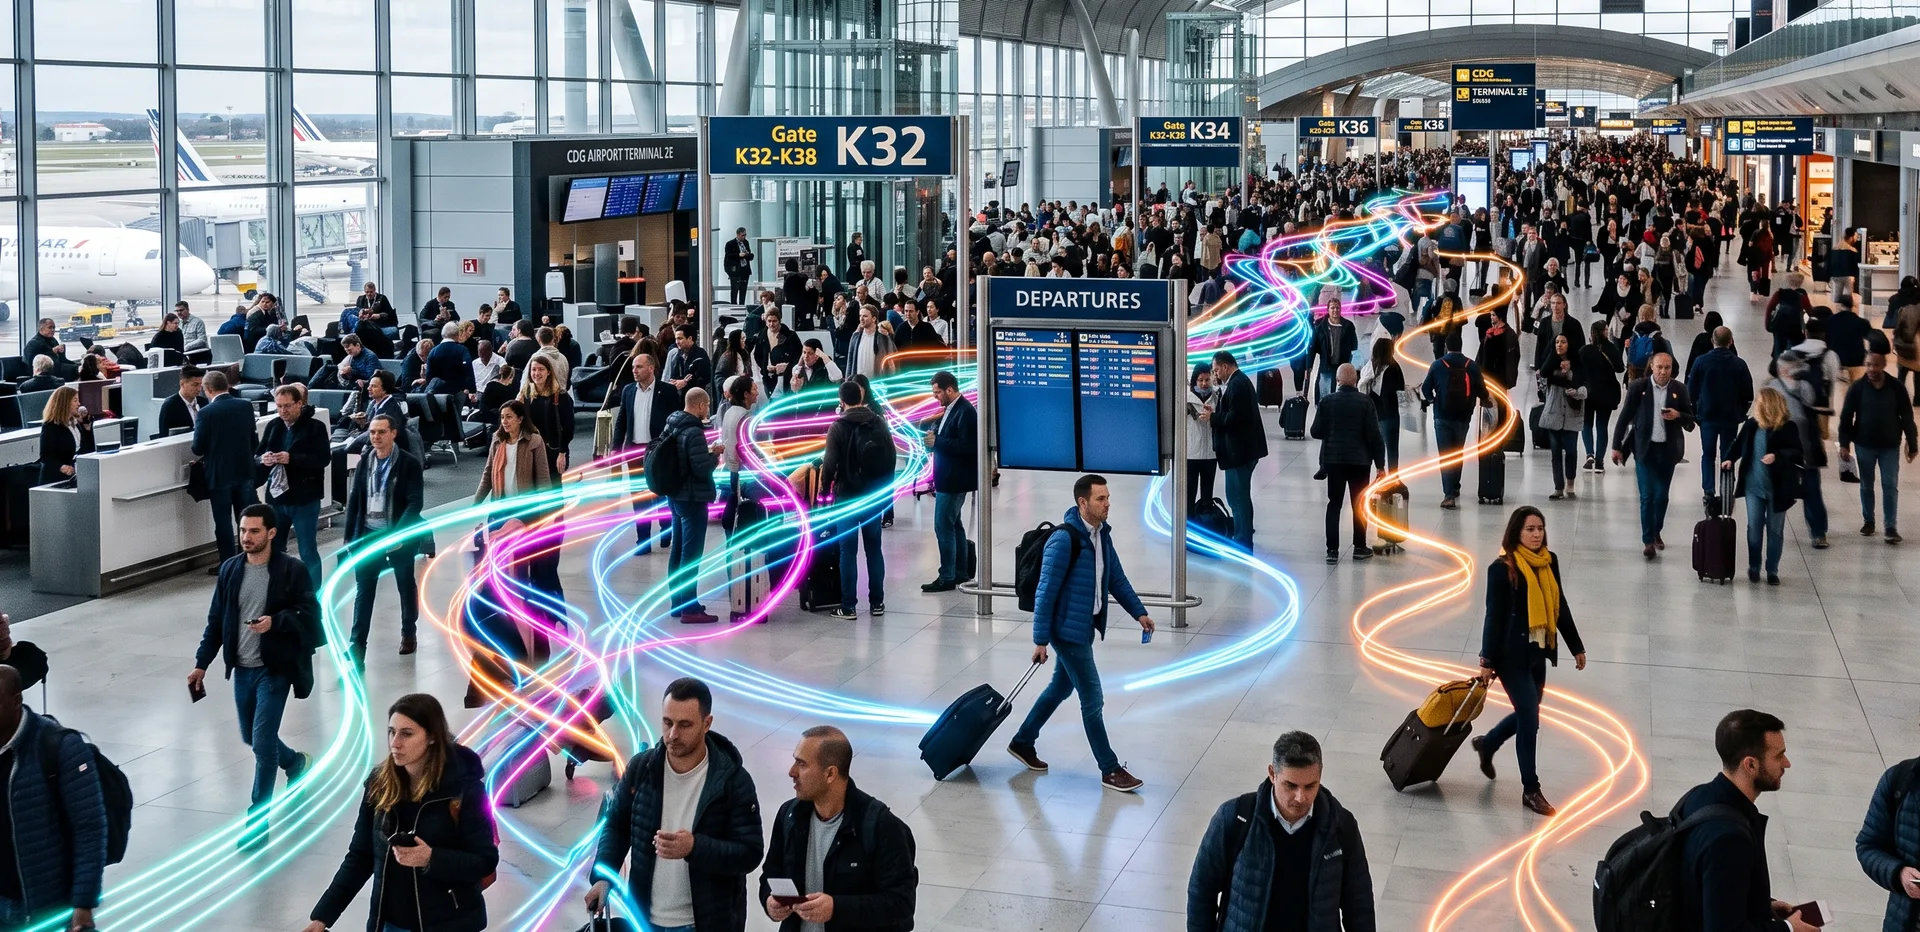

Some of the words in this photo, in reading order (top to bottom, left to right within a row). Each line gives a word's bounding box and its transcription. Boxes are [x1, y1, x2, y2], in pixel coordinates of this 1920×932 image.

[1472, 69, 1494, 78] CDG
[1472, 88, 1515, 96] TERMINAL
[771, 125, 817, 143] Gate
[1163, 121, 1185, 130] Gate
[1190, 121, 1231, 140] K34
[1339, 120, 1369, 134] K36
[567, 149, 586, 163] CDG
[587, 147, 623, 162] AIRPORT
[624, 146, 663, 160] TERMINAL
[664, 146, 674, 159] 2E
[837, 126, 927, 166] K32
[736, 147, 817, 165] K32-K38
[1016, 290, 1141, 309] DEPARTURES
